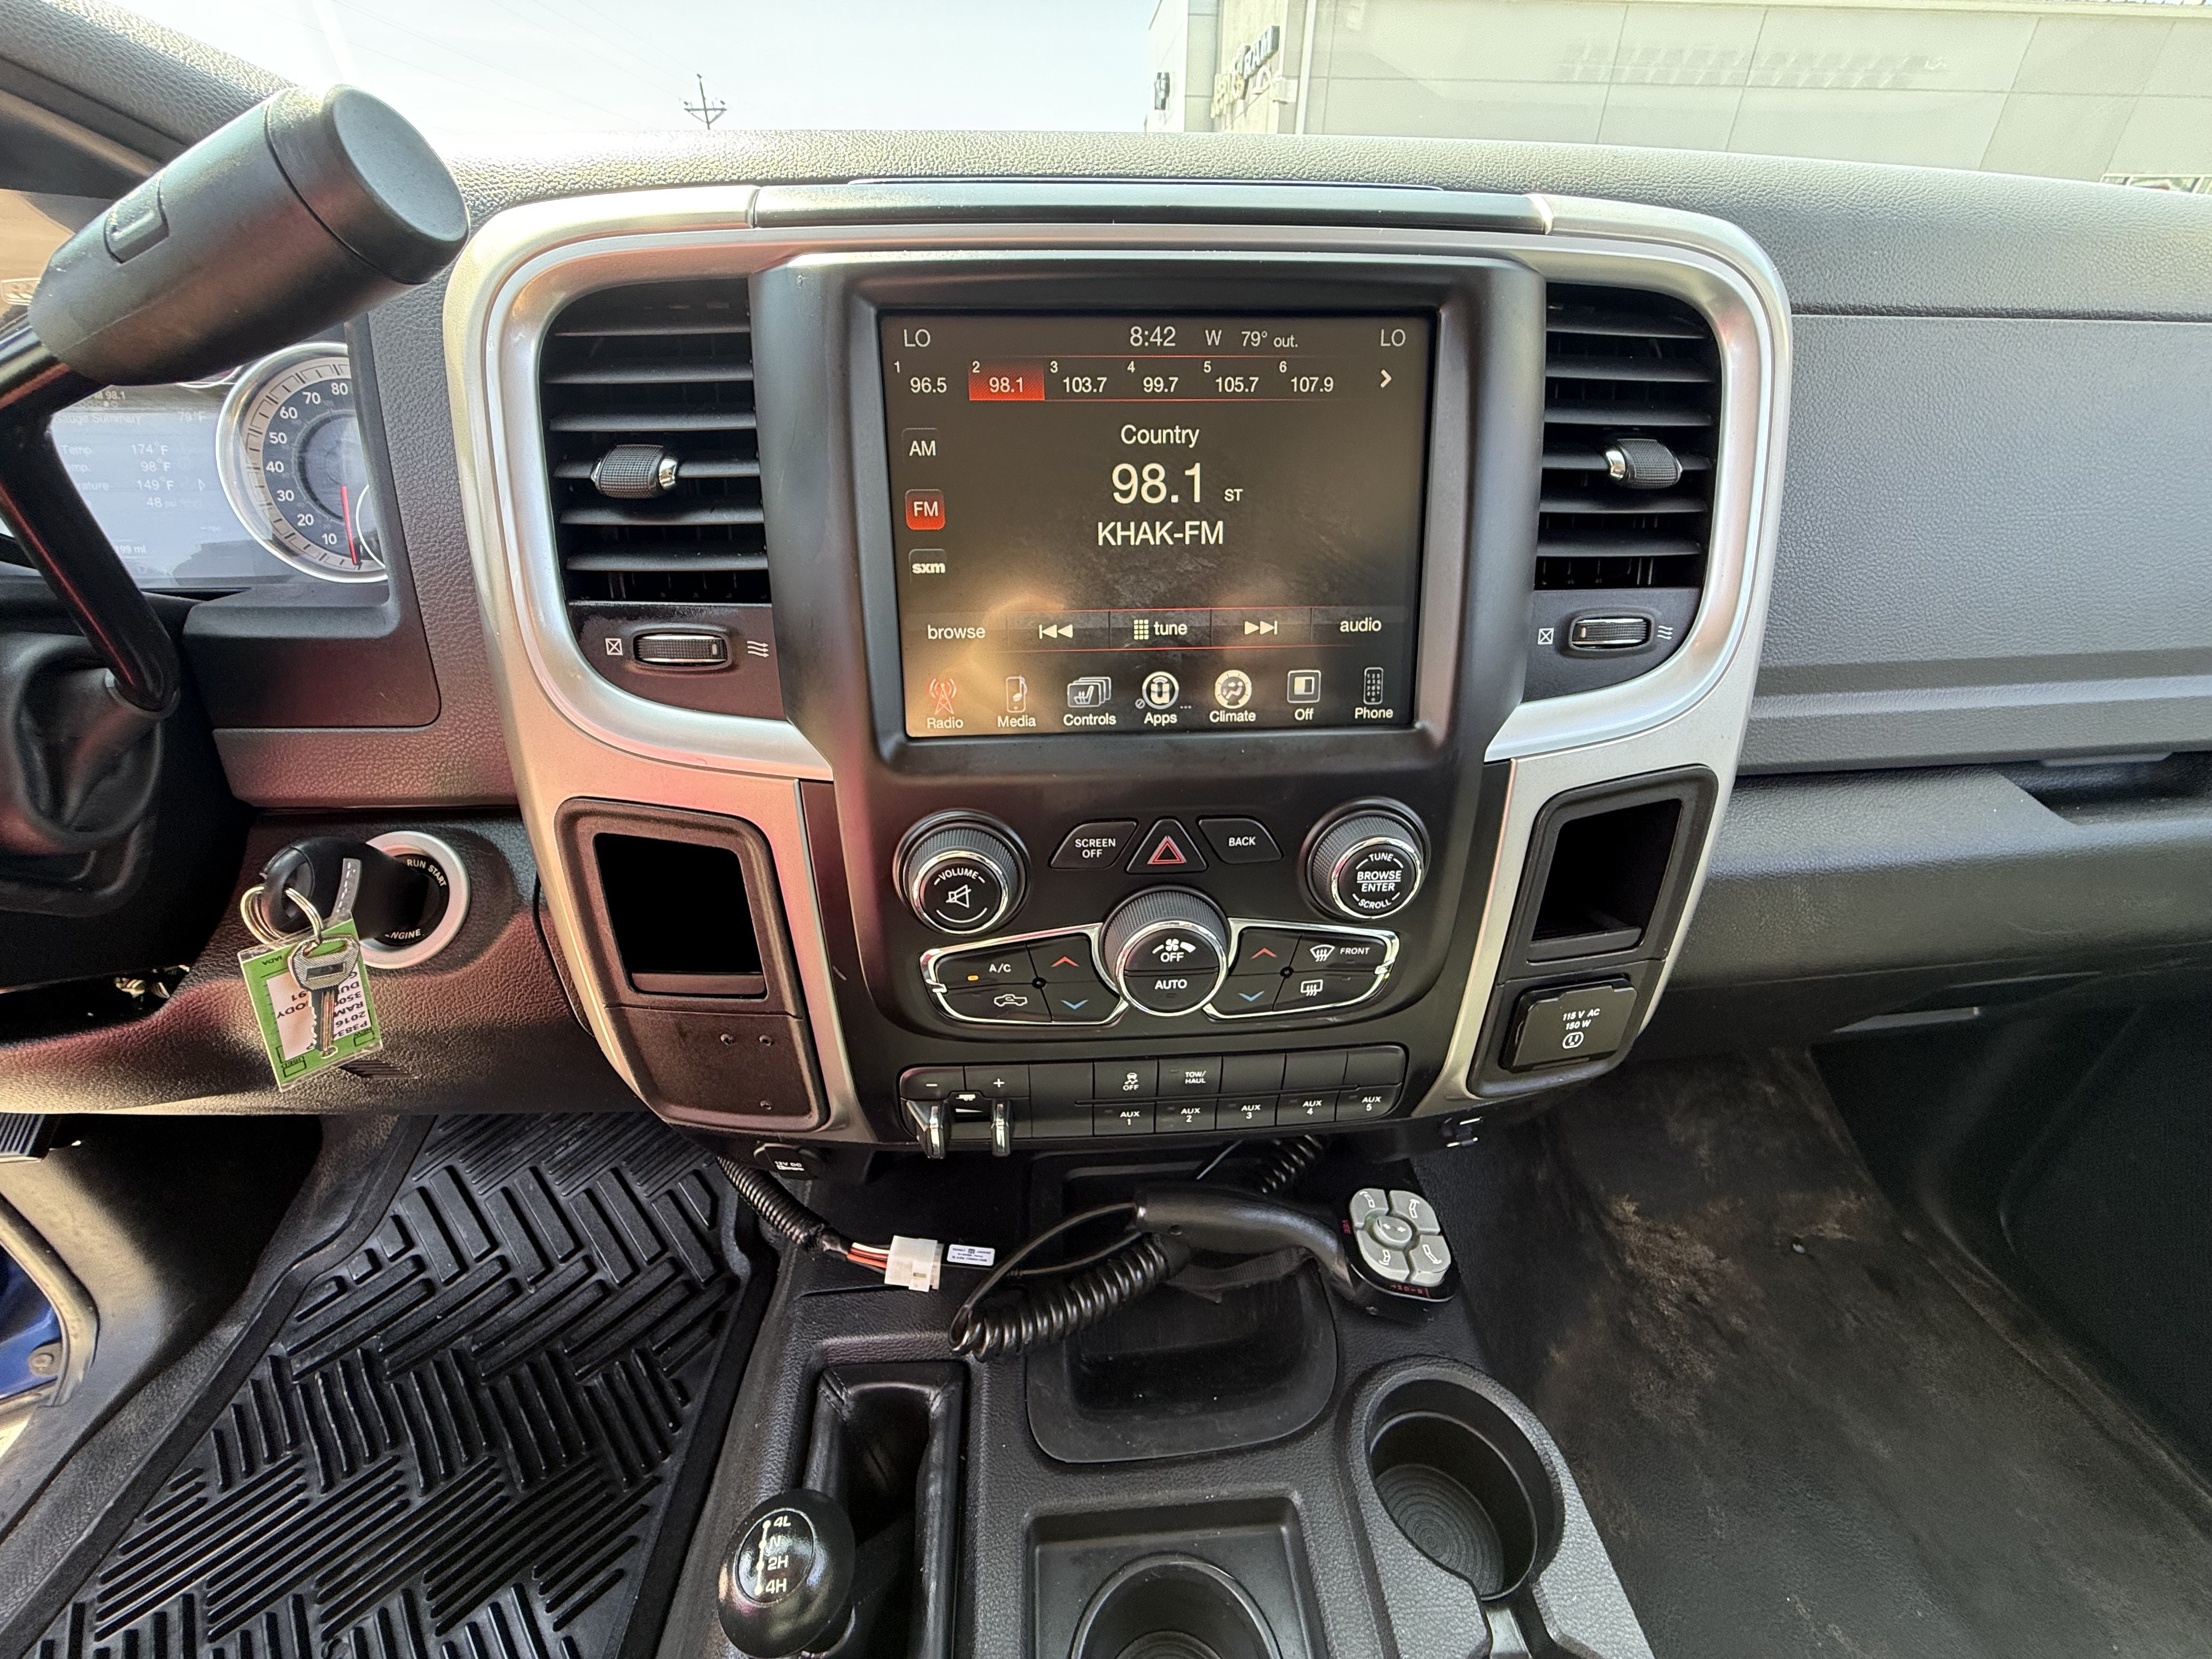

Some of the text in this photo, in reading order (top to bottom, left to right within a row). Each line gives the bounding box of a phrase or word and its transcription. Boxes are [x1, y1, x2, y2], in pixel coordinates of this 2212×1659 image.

[904, 329, 931, 347] LO
[1130, 326, 1176, 347] 8:42
[1205, 329, 1222, 346] W
[1241, 330, 1298, 348] 79° out.
[1380, 329, 1406, 347] LO
[894, 360, 947, 393] 1 96.5
[972, 361, 1024, 393] 2 98.1
[1050, 361, 1107, 393] 3 103.7
[1127, 360, 1179, 393] 4 99.7
[1203, 360, 1259, 393] 5 105.7
[1279, 360, 1334, 392] 6 107.9
[105, 390, 126, 400] 98.1
[331, 382, 348, 396] 80
[302, 391, 321, 404] 70
[279, 406, 298, 419] 60
[269, 432, 288, 444] 50
[1121, 424, 1200, 448] Country
[909, 441, 936, 456] AM
[65, 464, 91, 474] emp.
[266, 460, 285, 473] 40
[1112, 462, 1244, 504] 98.1 ST
[276, 489, 295, 502] 30
[146, 497, 162, 508] 48
[914, 503, 938, 516] FM
[297, 513, 314, 527] 20
[321, 533, 337, 545] 10
[1098, 520, 1223, 546] KHAK-FM
[912, 562, 946, 574] sxm
[1153, 621, 1188, 636] tune
[1340, 617, 1382, 633] audio
[927, 624, 987, 641] browse
[1063, 713, 1117, 726] Controls
[1143, 712, 1178, 727] Apps
[1209, 709, 1256, 723] Climate
[1294, 708, 1314, 721] Off
[1355, 707, 1393, 719] Phone
[926, 716, 964, 730] Radio
[996, 714, 1036, 728] Media
[1075, 838, 1116, 848] SCREEN
[1228, 836, 1256, 847] BACK
[1082, 849, 1103, 859] OFF
[1369, 852, 1393, 862] TUNE
[407, 859, 447, 887] RUN START
[939, 868, 978, 882] VOLUME
[1357, 870, 1402, 881] BROWSE
[1361, 882, 1396, 893] ENTER
[1358, 897, 1392, 909] SCROLL
[1160, 951, 1184, 962] OFF
[989, 963, 1012, 973] A/C
[1154, 979, 1188, 990] AUTO
[276, 1002, 308, 1019] ODY
[1562, 1008, 1600, 1021] 115 V AC
[335, 1011, 366, 1028] 2016
[1565, 1019, 1592, 1030] 150 W
[1302, 1100, 1322, 1108] AUX
[1362, 1096, 1382, 1104] AUX
[1181, 1107, 1200, 1116] AUX
[1241, 1104, 1261, 1113] AUX
[773, 1515, 791, 1527] 4L
[769, 1536, 781, 1547] N
[768, 1555, 789, 1570] 2H
[765, 1578, 787, 1594] 4H
